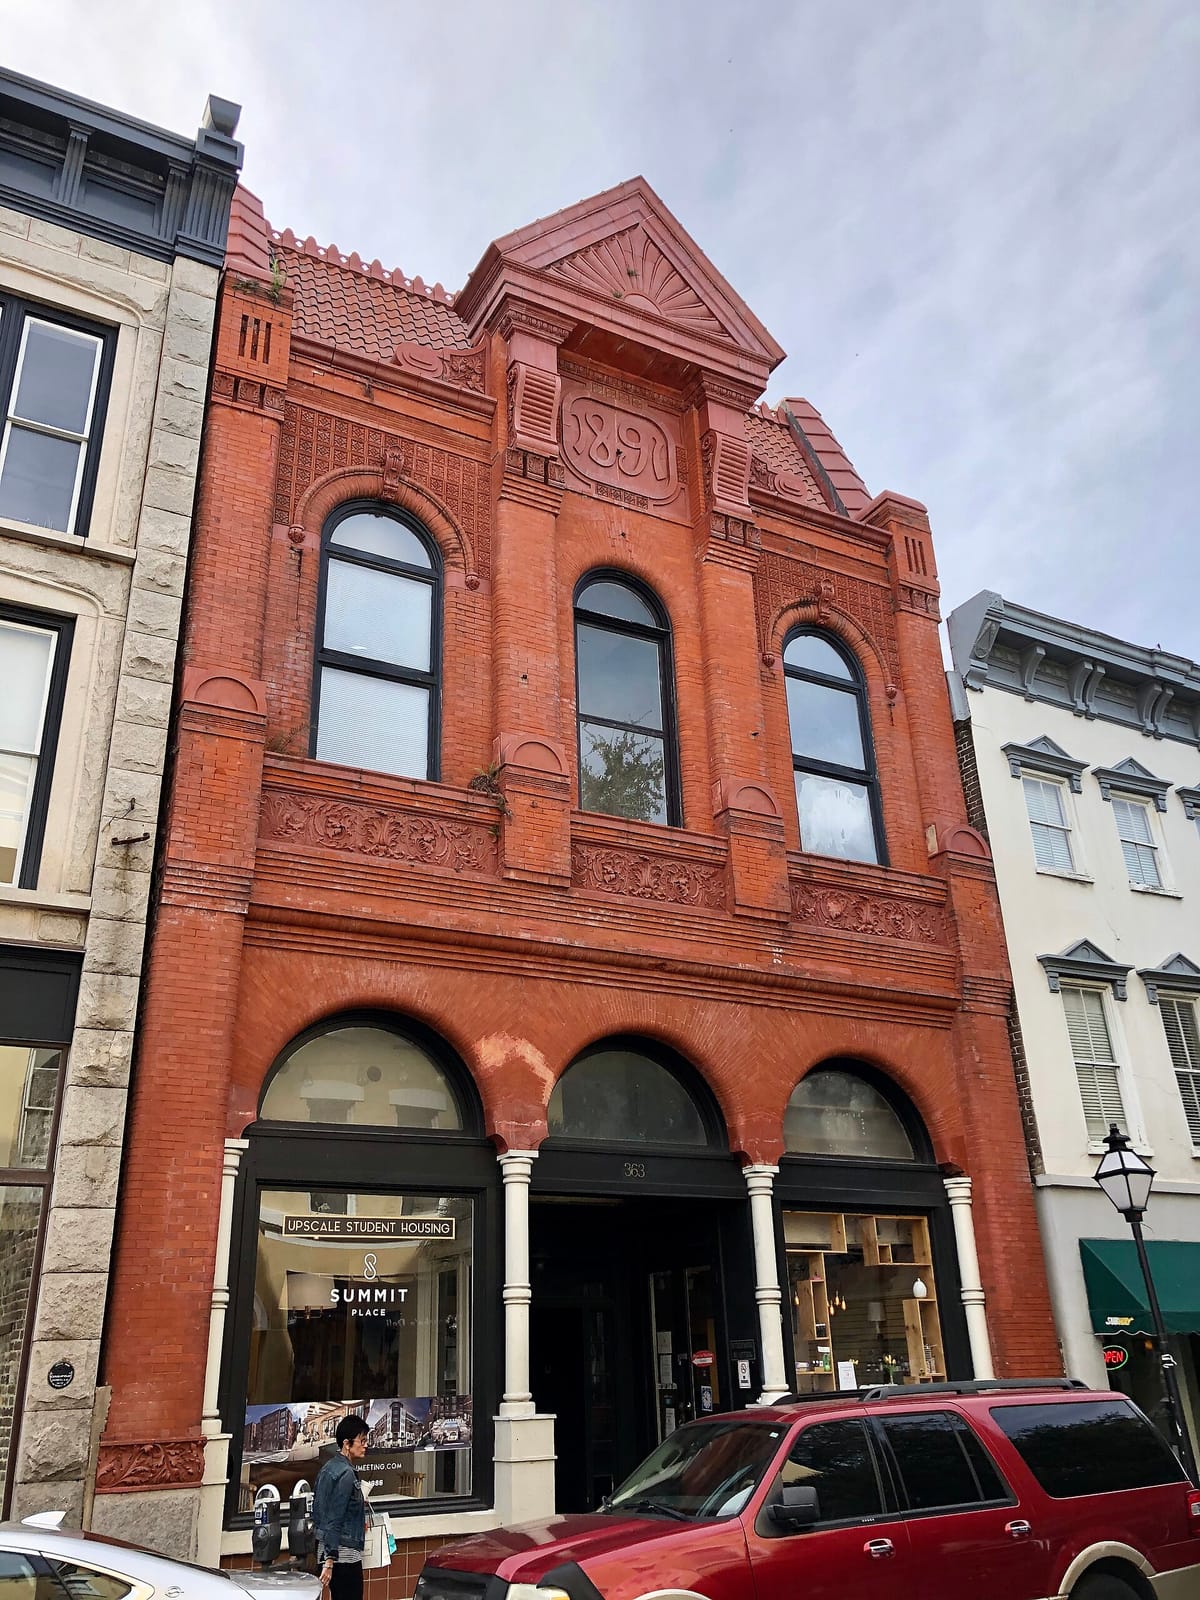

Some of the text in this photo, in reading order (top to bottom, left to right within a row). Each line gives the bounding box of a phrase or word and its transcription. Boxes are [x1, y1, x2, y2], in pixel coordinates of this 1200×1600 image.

[570, 410, 668, 481] 1891
[624, 1162, 646, 1178] 363
[288, 1220, 450, 1234] UPSCALE STUDENT HOUSING
[330, 1288, 408, 1303] SUMMIT
[351, 1308, 386, 1317] PLACE
